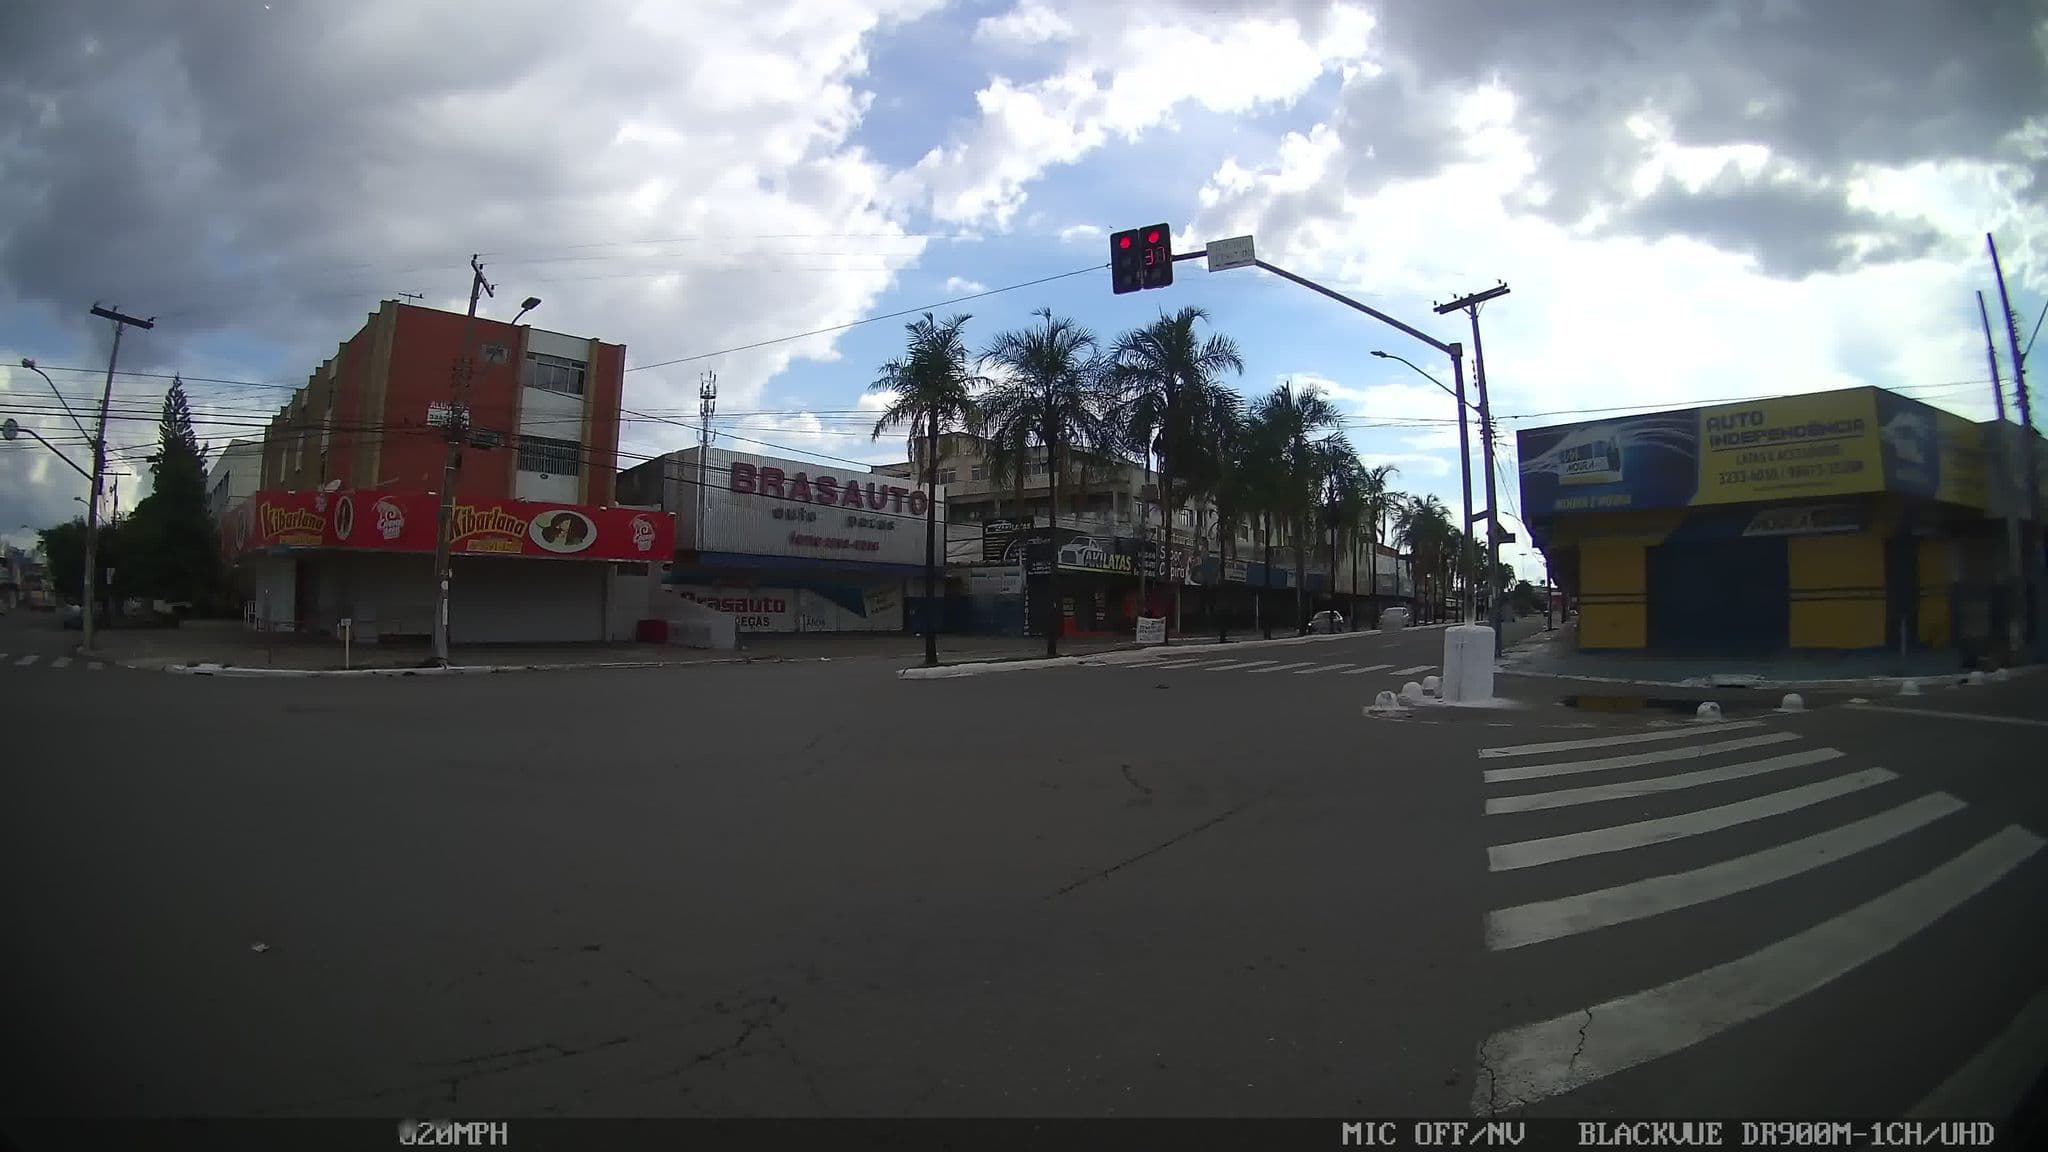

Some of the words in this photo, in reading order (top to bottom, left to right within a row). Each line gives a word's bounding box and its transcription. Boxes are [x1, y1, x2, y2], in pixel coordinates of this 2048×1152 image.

[1145, 246, 1166, 266] 37
[1706, 411, 1763, 433] AUTO
[731, 462, 929, 516] BRASAUTO
[1084, 549, 1132, 572] AKILATAS
